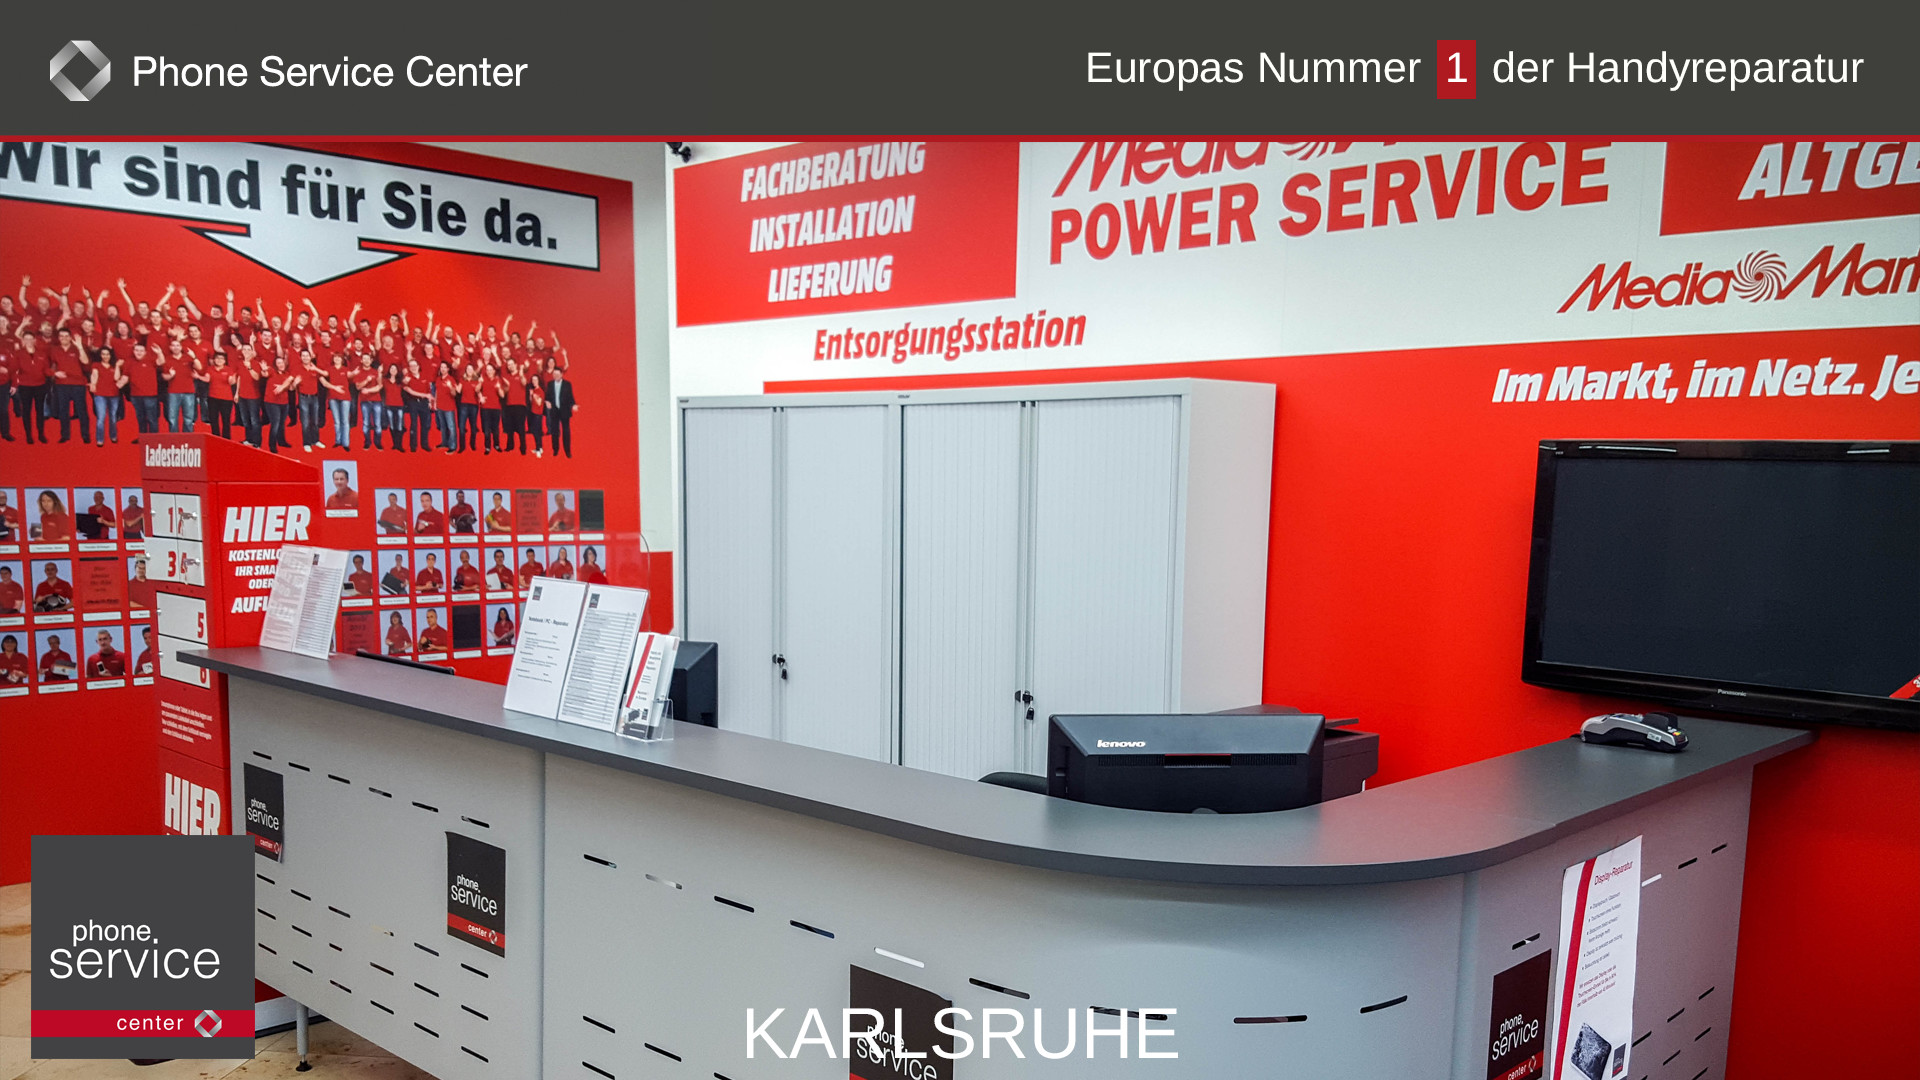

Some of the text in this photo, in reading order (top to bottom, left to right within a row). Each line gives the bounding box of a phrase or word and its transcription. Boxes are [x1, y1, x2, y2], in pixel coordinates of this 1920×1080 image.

[741, 142, 926, 202] FACHBERATUNG
[0, 142, 557, 249] Wir sind für Sie da.
[1050, 142, 1612, 266] POWER SERVICE
[749, 195, 916, 253] INSTALLATION
[768, 255, 893, 302] LIEFERUNG
[1556, 261, 1738, 314] Media
[813, 309, 1087, 364] Entsorgungsstation
[1492, 368, 1544, 402] Im
[1545, 362, 1679, 404] Markt,
[1685, 359, 1746, 398] im
[1749, 357, 1865, 398] Netz.
[145, 443, 202, 468] Ladestation
[168, 507, 174, 533] 1
[223, 505, 311, 543] HIER
[167, 550, 177, 577] 3
[235, 565, 253, 576] IHR
[197, 612, 205, 638] 5
[1097, 739, 1146, 748] lenovo
[165, 772, 221, 835] HIER
[247, 807, 279, 831] service
[450, 885, 498, 916] service
[467, 924, 488, 938] center
[1491, 1019, 1539, 1061] service
[1507, 1064, 1527, 1080] center
